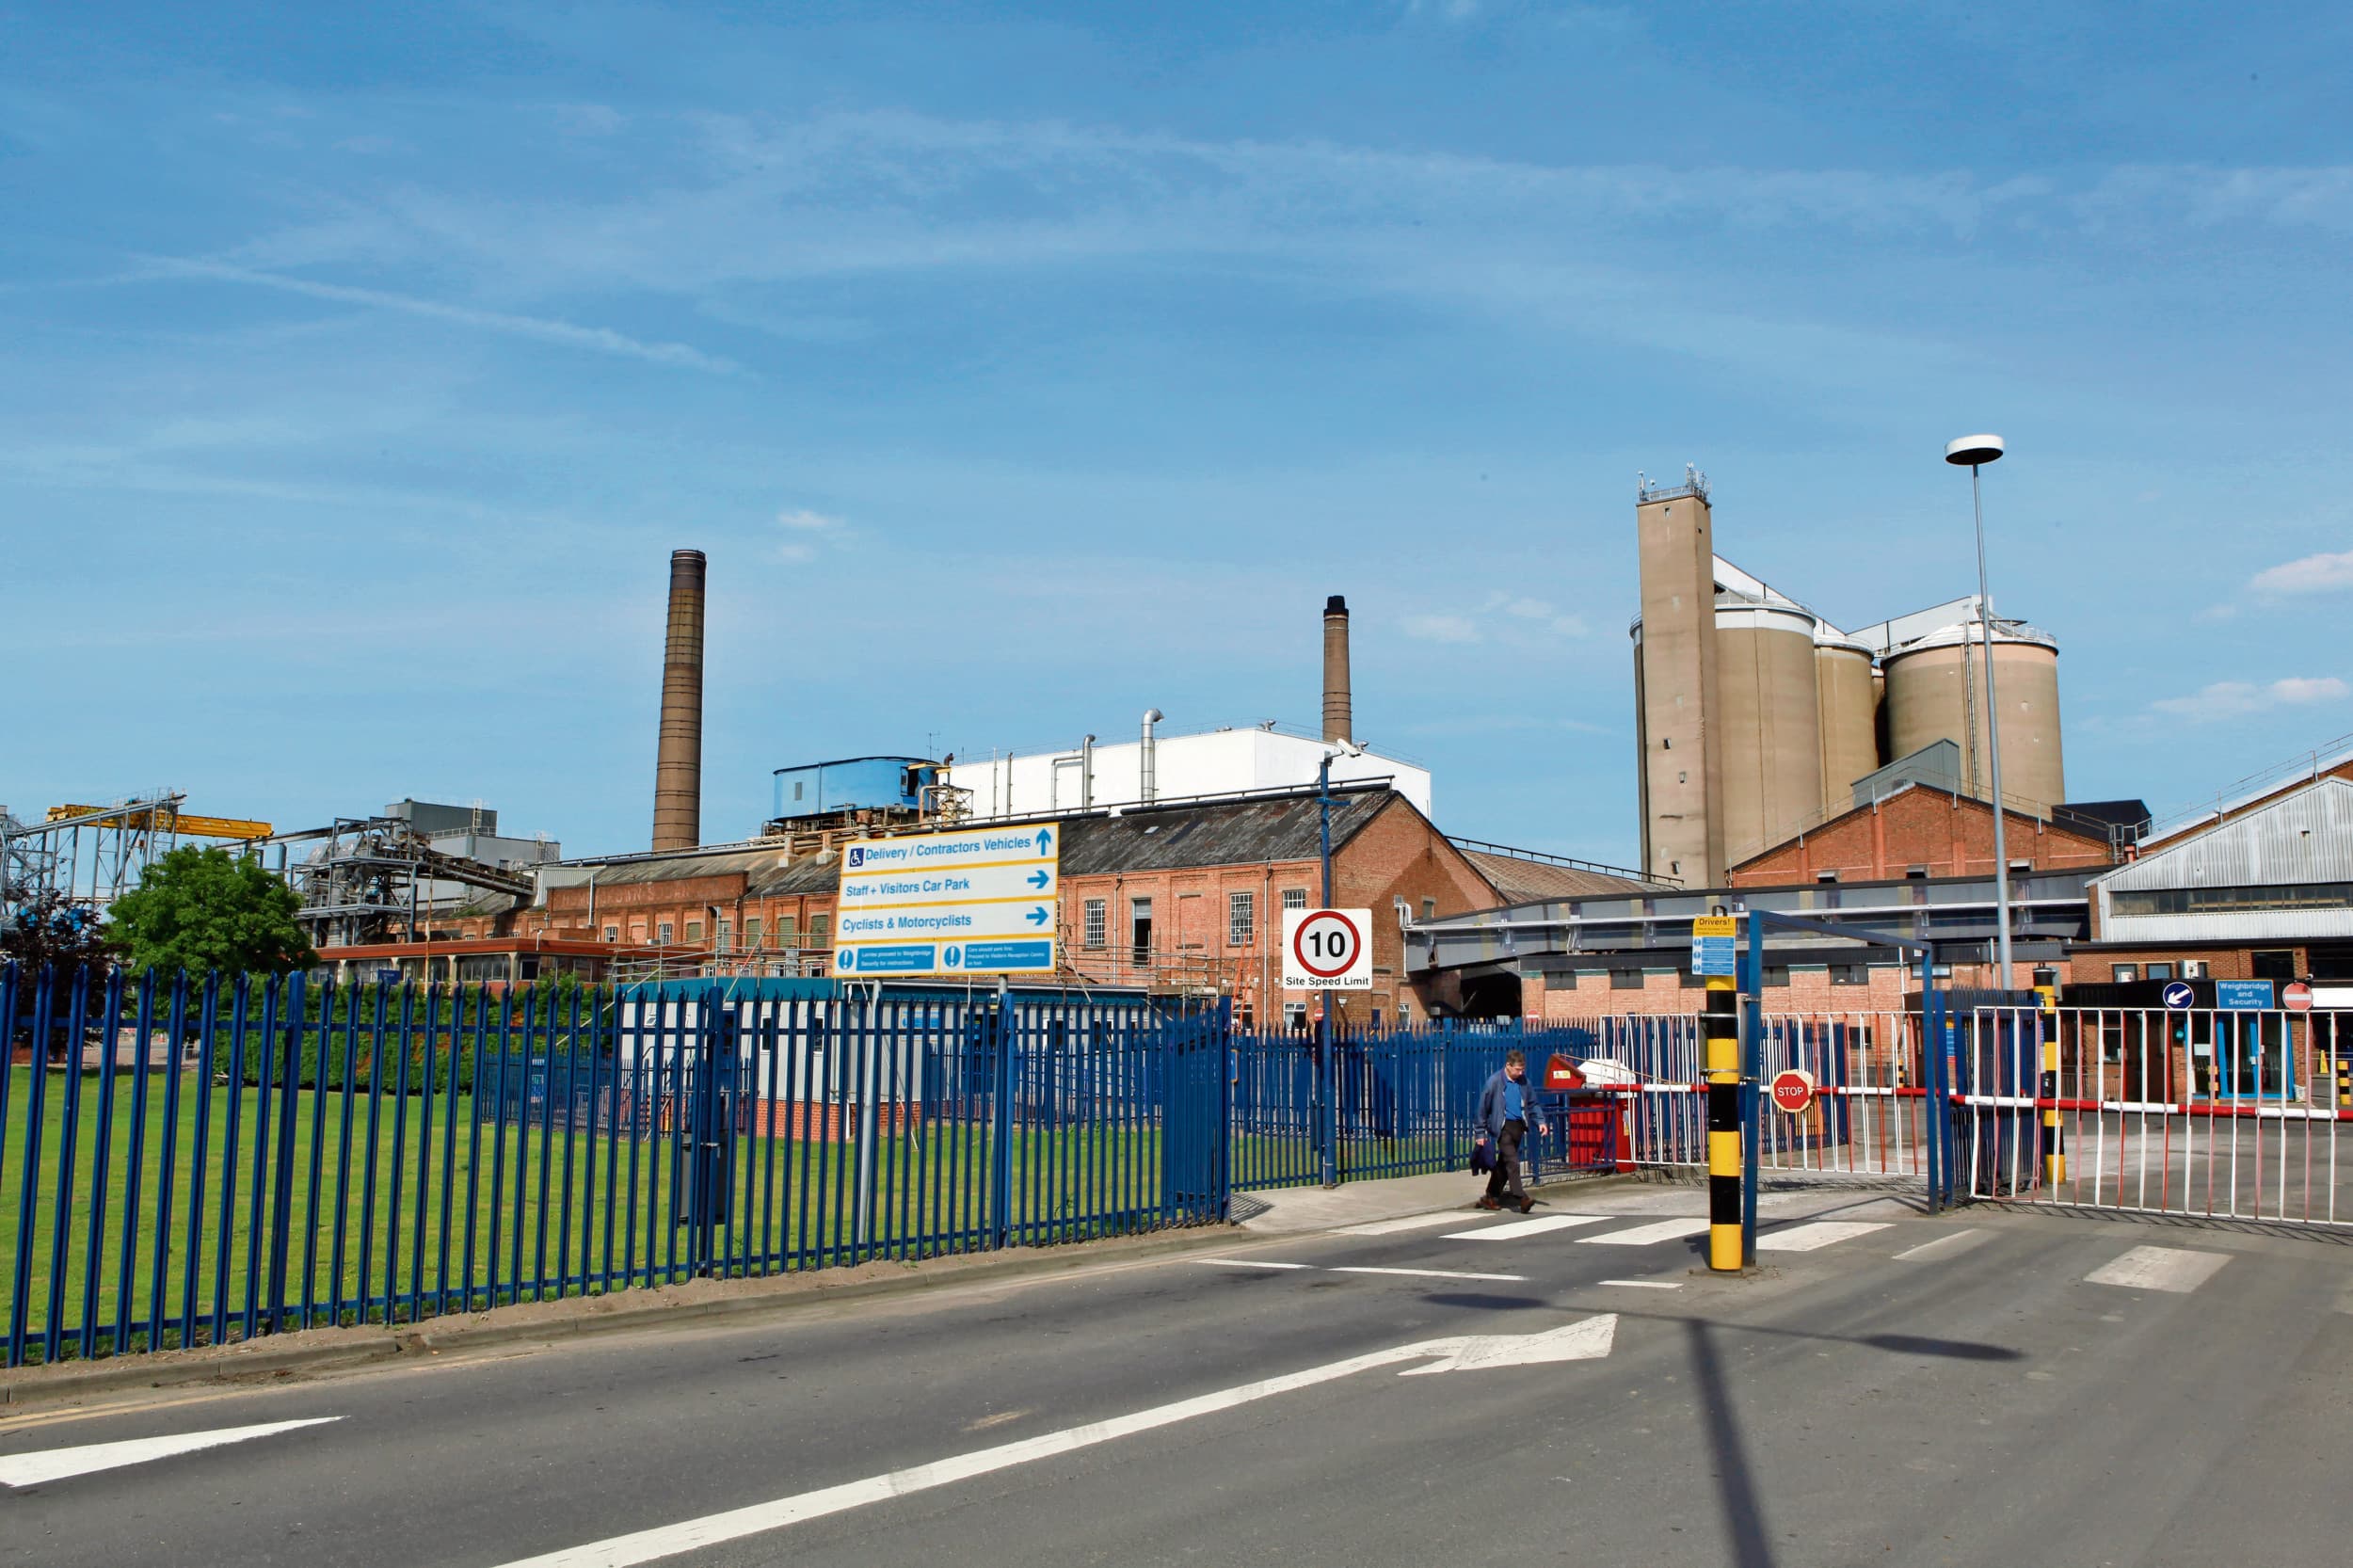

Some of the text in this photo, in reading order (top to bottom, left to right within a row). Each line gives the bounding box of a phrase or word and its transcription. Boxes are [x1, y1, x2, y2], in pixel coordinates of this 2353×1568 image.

[866, 848, 907, 860] Delivery
[917, 841, 980, 856] Contractors
[984, 837, 1031, 851] Vehicles
[846, 885, 869, 897] Staff
[880, 882, 920, 894] Visitors
[923, 880, 941, 892] Car
[945, 878, 969, 890] Park
[842, 915, 971, 933] Cyclists & Motorcyclists
[1699, 918, 1730, 926] Drivers!
[1309, 931, 1345, 957] 10
[1286, 977, 1369, 987] Site Speed Limit
[2228, 998, 2263, 1006] Security
[1777, 1086, 1803, 1096] STOP
